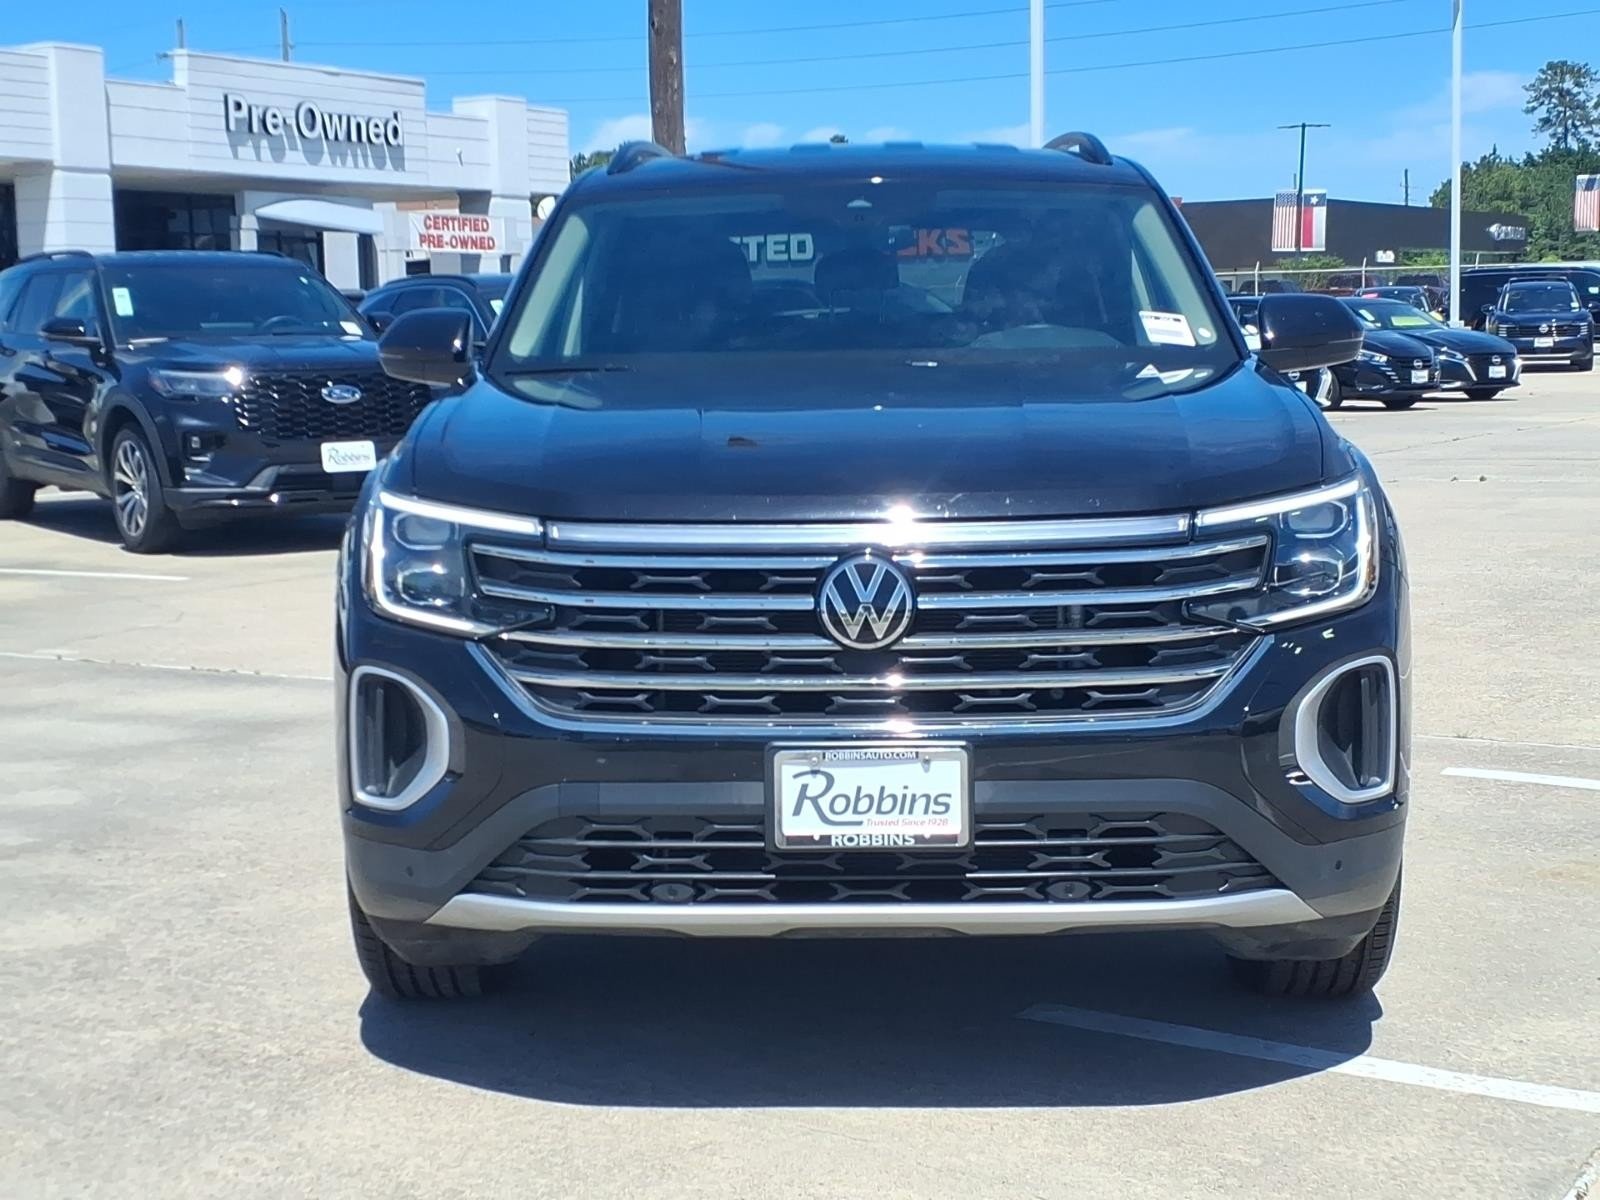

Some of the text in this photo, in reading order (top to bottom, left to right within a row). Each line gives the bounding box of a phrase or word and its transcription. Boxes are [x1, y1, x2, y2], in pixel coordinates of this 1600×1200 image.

[223, 93, 403, 147] Pre-Owned
[424, 215, 489, 232] CERTIFIED
[419, 233, 495, 250] PRE-OWNED
[729, 233, 814, 262] TED
[792, 769, 952, 826] Robbins
[867, 818, 899, 827] Trusted
[901, 818, 926, 826] Since
[831, 833, 916, 847] ROBBINS
